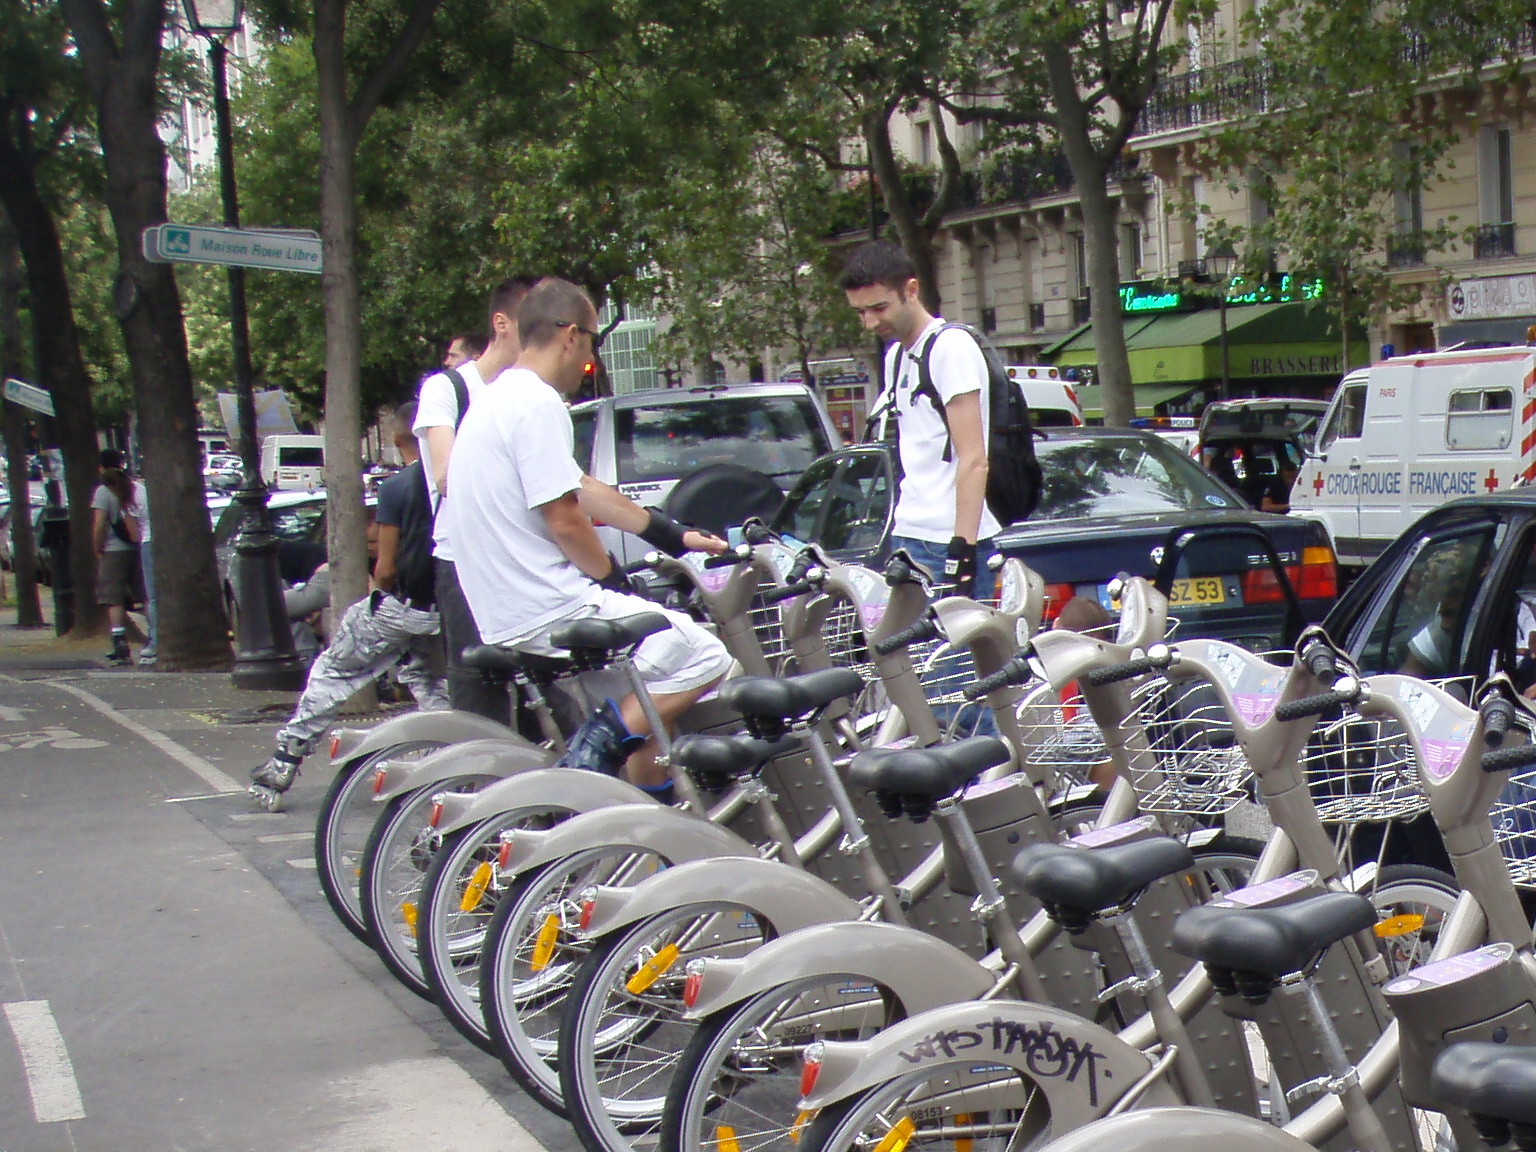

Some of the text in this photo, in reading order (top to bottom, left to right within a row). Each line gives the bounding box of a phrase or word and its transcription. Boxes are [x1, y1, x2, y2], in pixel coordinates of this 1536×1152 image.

[200, 237, 319, 263] Maison Roue Libre
[1251, 354, 1340, 374] BRASSERI
[1379, 387, 1397, 398] PARIS
[1172, 418, 1194, 427] POLICE
[1327, 471, 1478, 498] CROIX ROUGE FRANÇAISE
[1196, 581, 1219, 600] 53
